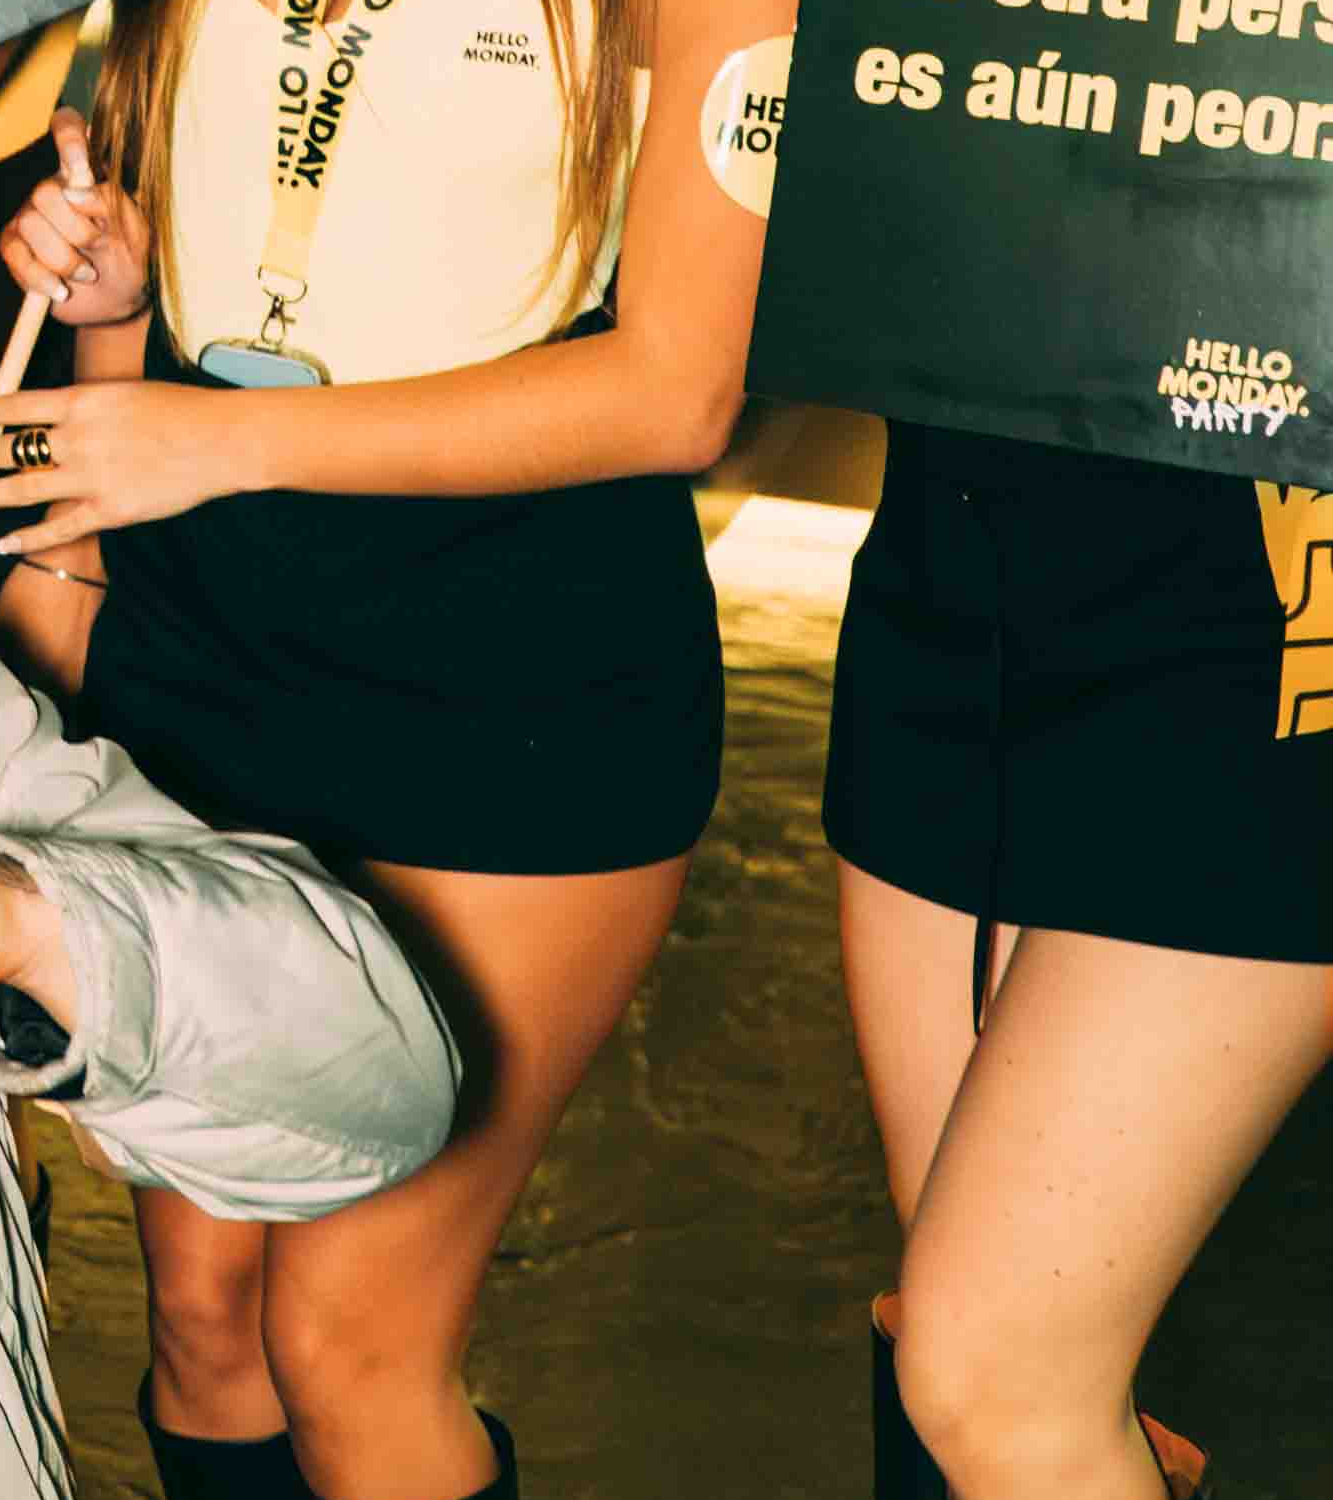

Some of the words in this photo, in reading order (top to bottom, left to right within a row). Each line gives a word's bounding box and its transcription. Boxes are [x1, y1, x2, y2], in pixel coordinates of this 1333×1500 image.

[476, 31, 529, 47] HELLO
[290, 22, 372, 189] MONDAY.
[744, 92, 786, 123] HE
[853, 42, 944, 113] es
[964, 49, 1119, 133] aún
[1183, 337, 1294, 383] HELLO
[1156, 364, 1311, 418] MONDAY.
[1170, 399, 1287, 438] PARTY
